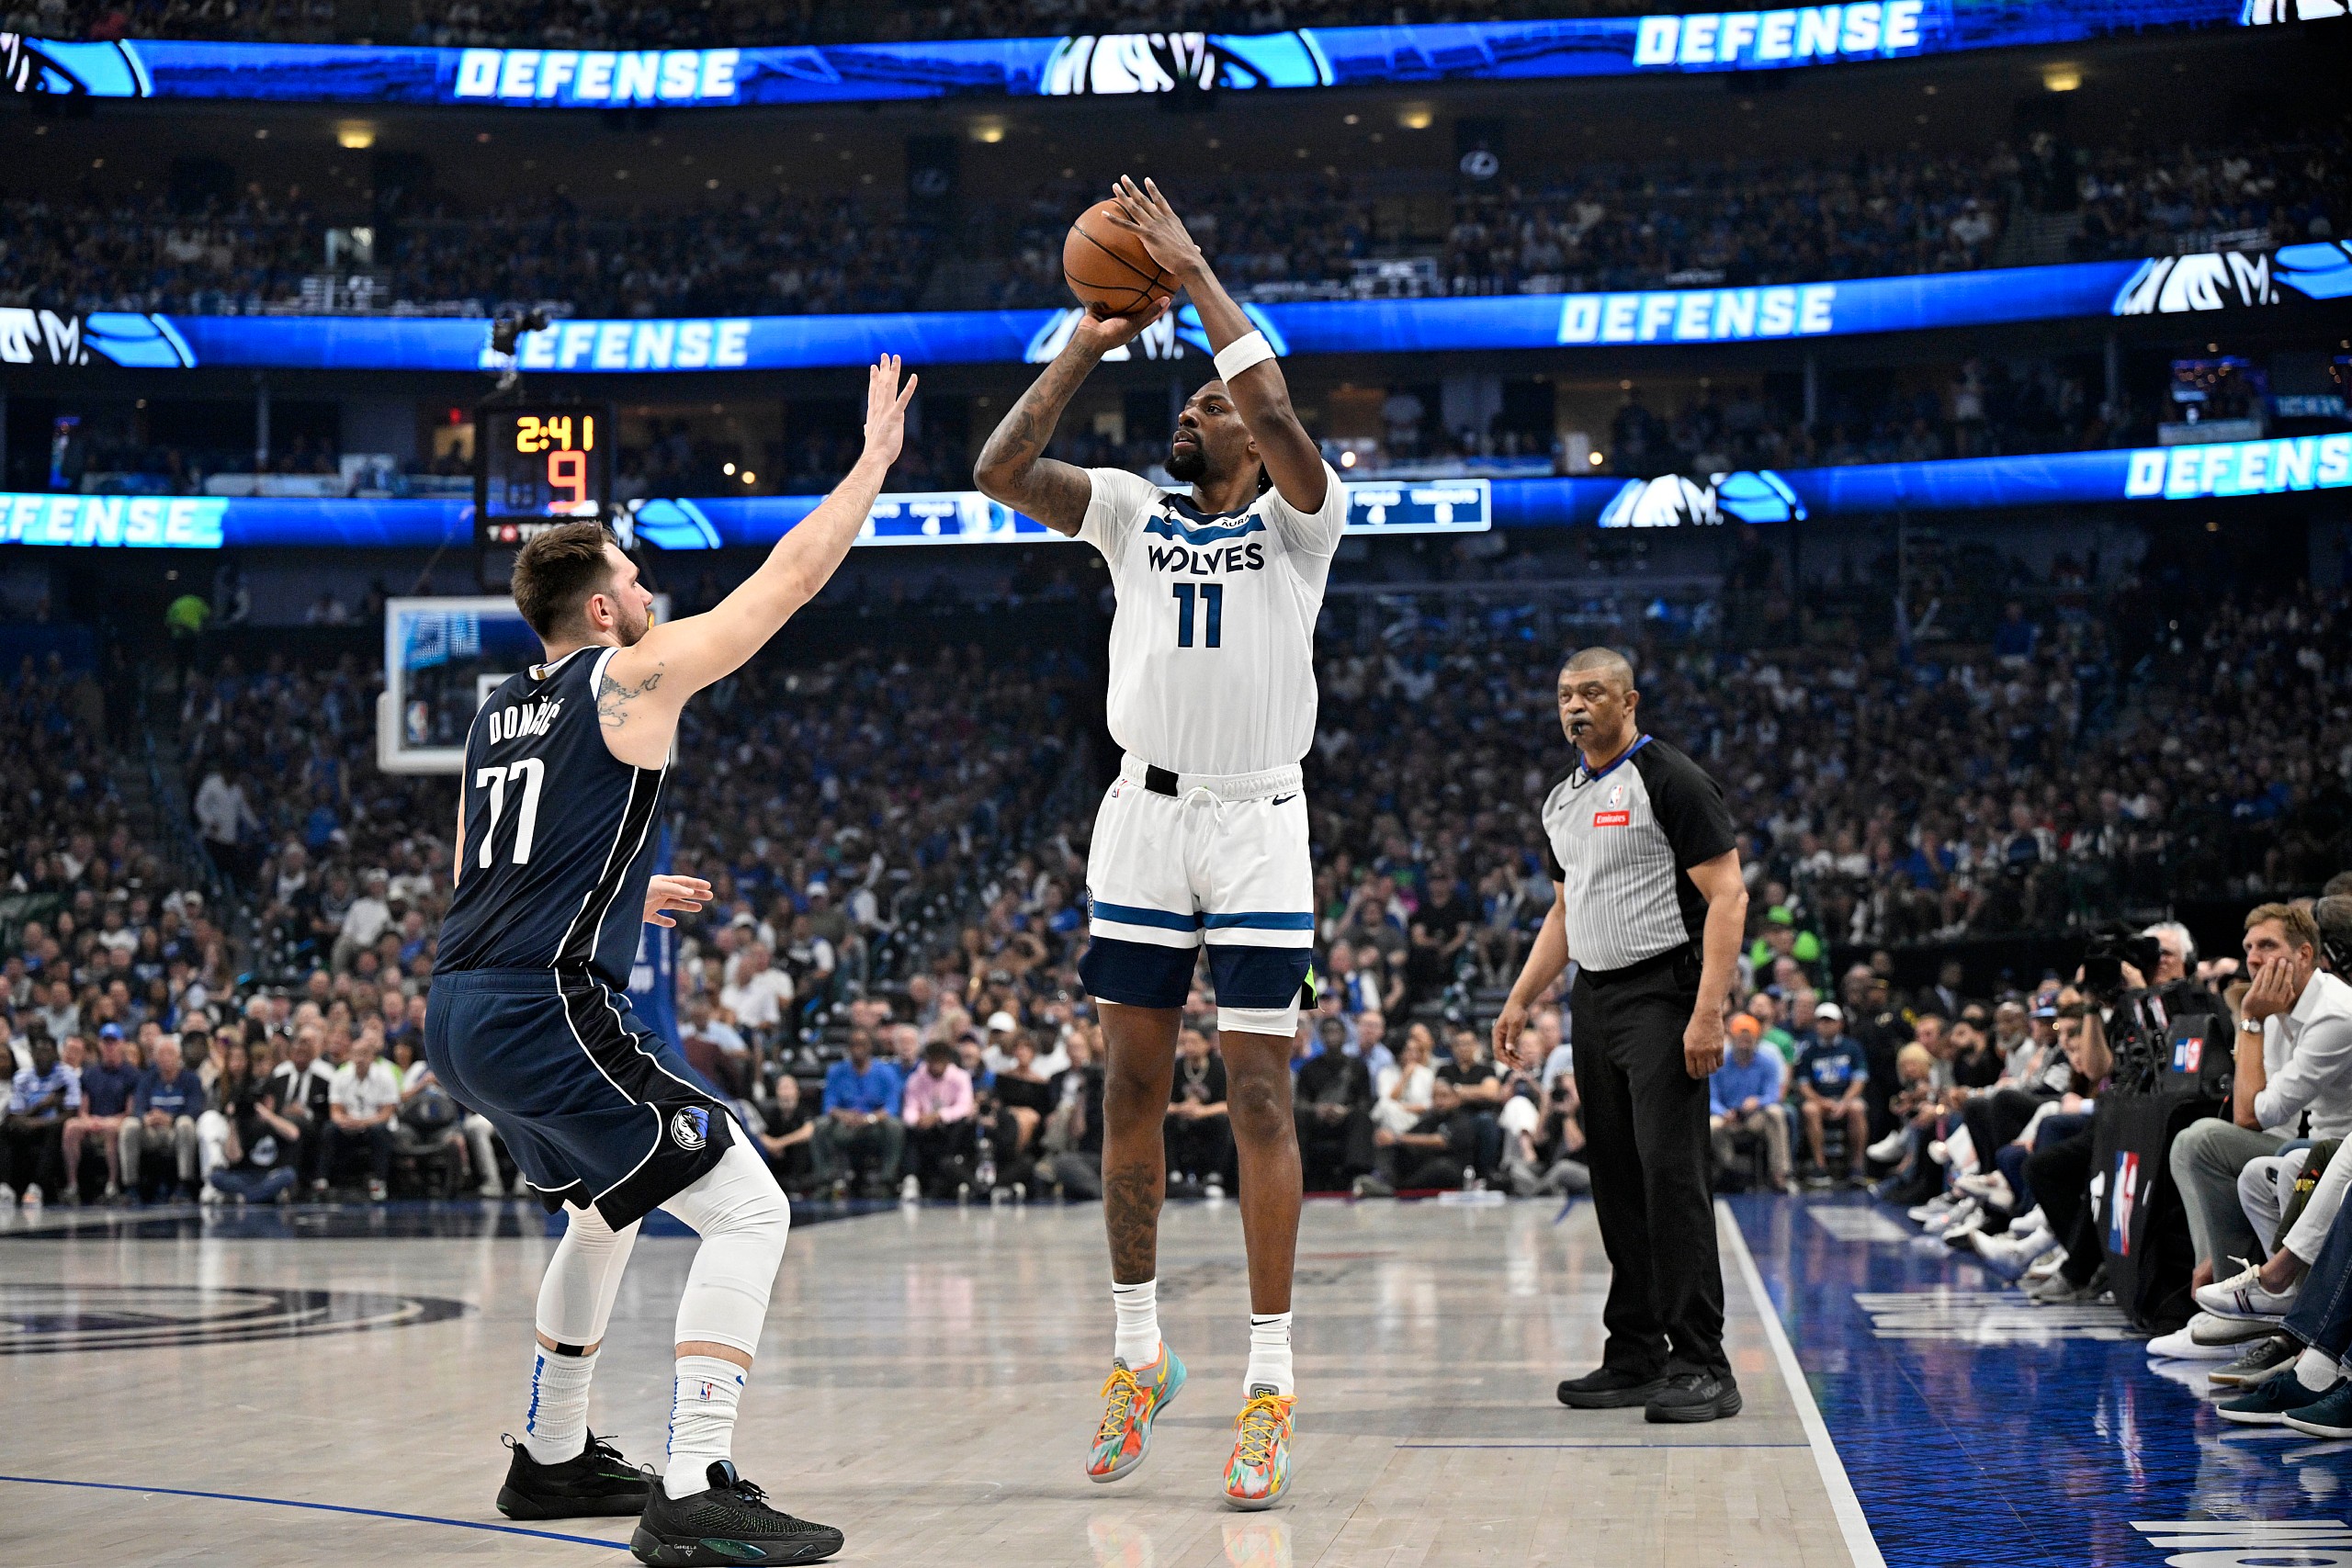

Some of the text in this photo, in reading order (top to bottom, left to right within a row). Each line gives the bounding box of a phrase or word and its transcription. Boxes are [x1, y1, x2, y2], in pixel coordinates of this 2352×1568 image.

[1634, 0, 1923, 67] DEFENSE
[455, 49, 740, 100] DEFENSE
[1557, 285, 1836, 344] DEFENSE
[516, 416, 594, 453] 2:41
[548, 450, 586, 513] 9
[1148, 543, 1264, 575] WOLVES
[1172, 582, 1223, 648] 11
[476, 757, 545, 869] 77
[1597, 815, 1626, 824] Emirates
